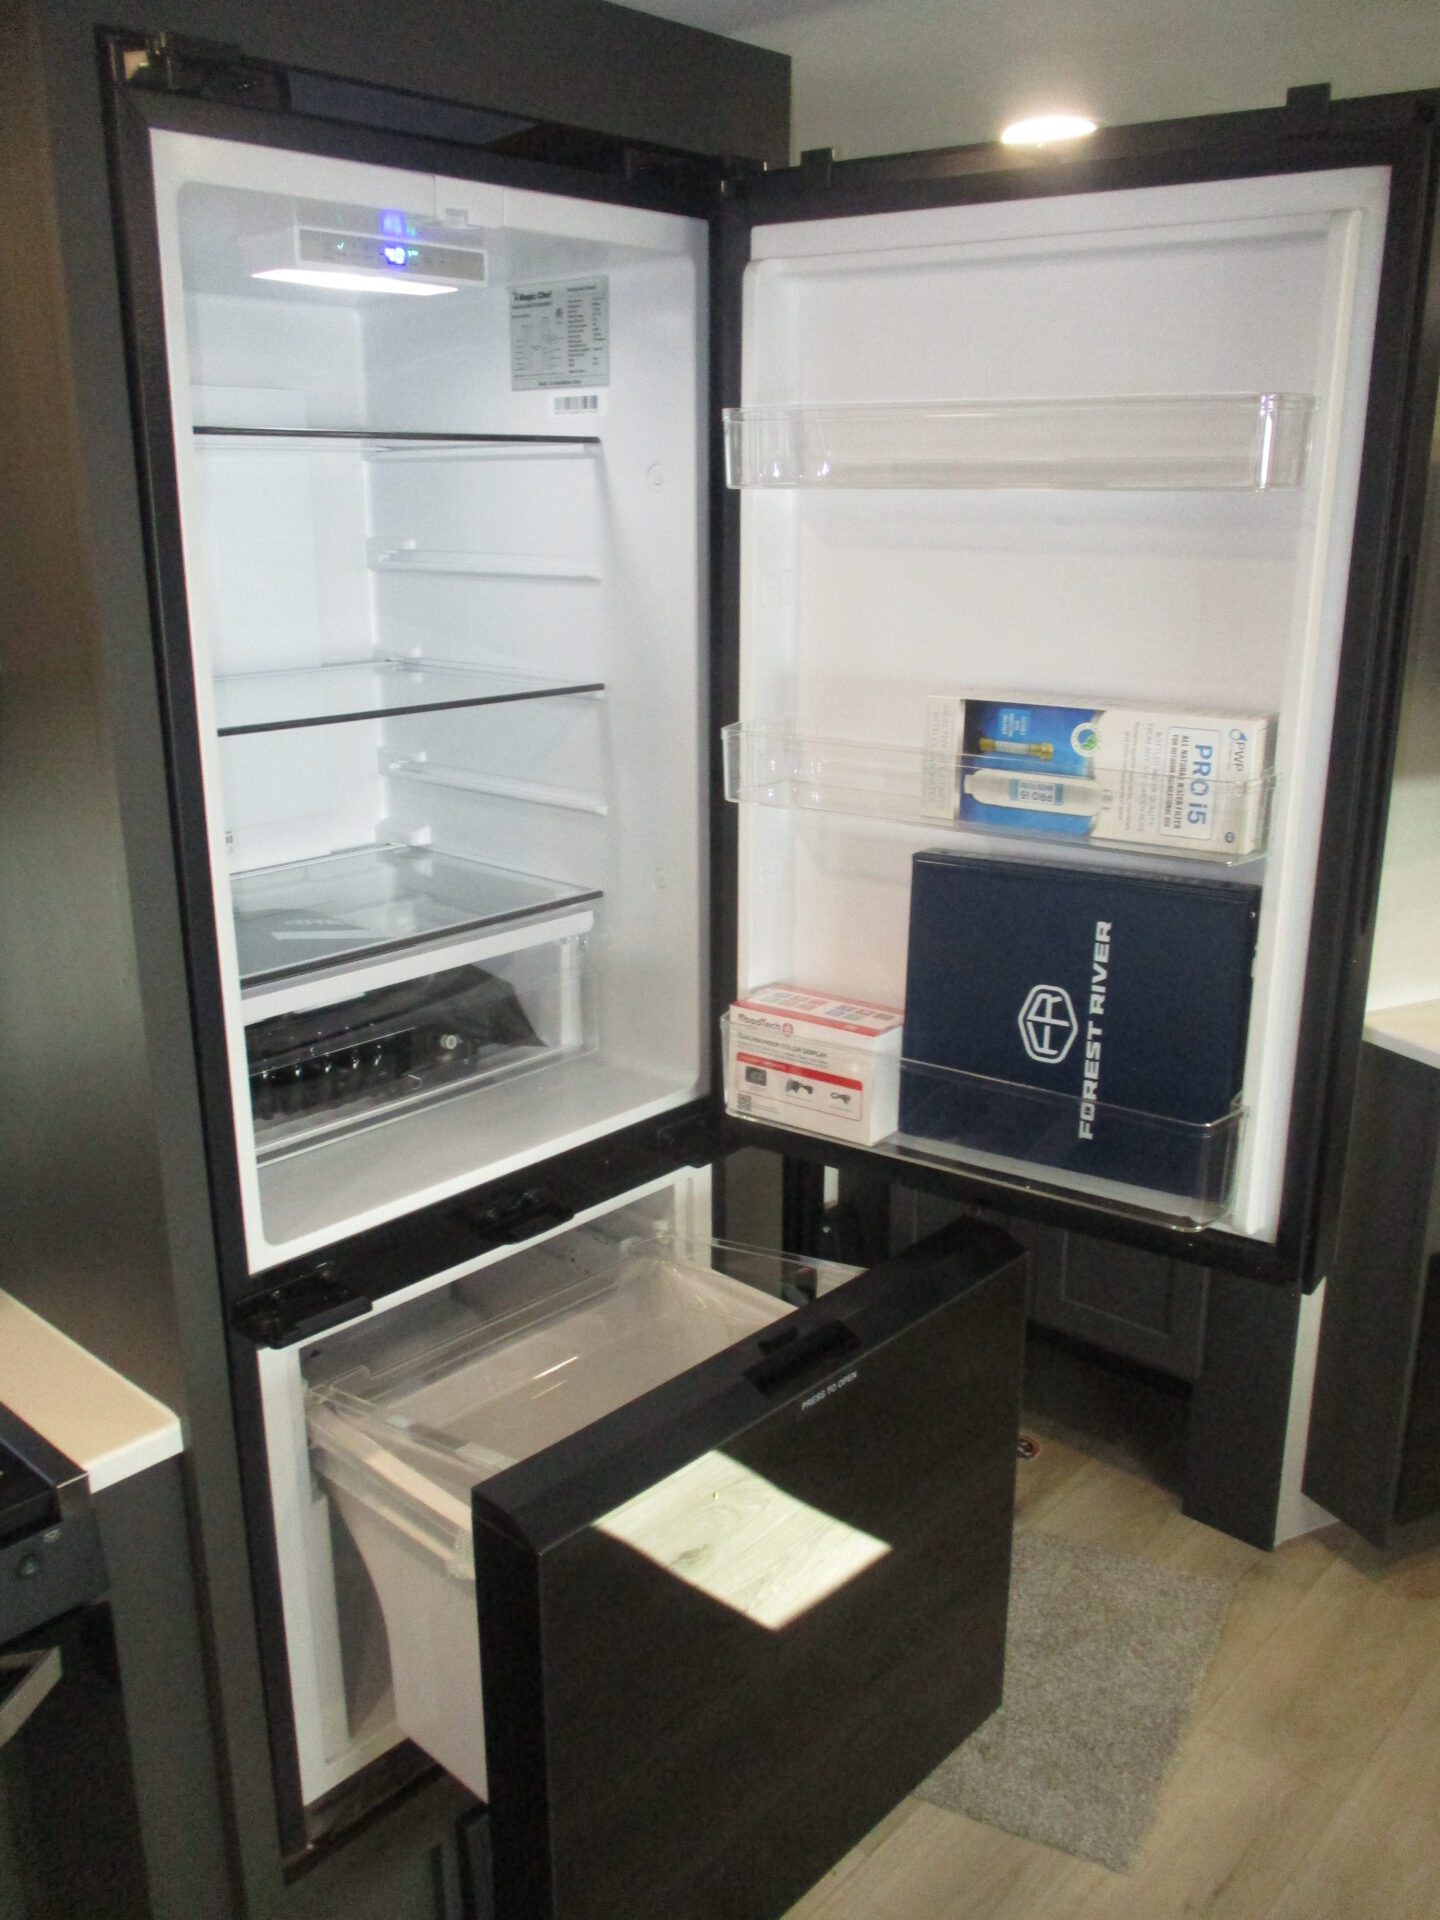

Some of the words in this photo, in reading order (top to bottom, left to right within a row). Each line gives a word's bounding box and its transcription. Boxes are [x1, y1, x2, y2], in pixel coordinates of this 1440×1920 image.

[1181, 735, 1190, 746] ALL
[1177, 749, 1188, 780] NATURAL
[1190, 744, 1214, 796] PRO
[1187, 802, 1208, 825] i5
[1089, 921, 1112, 1015] RIVER
[1078, 1020, 1103, 1140] FOREST
